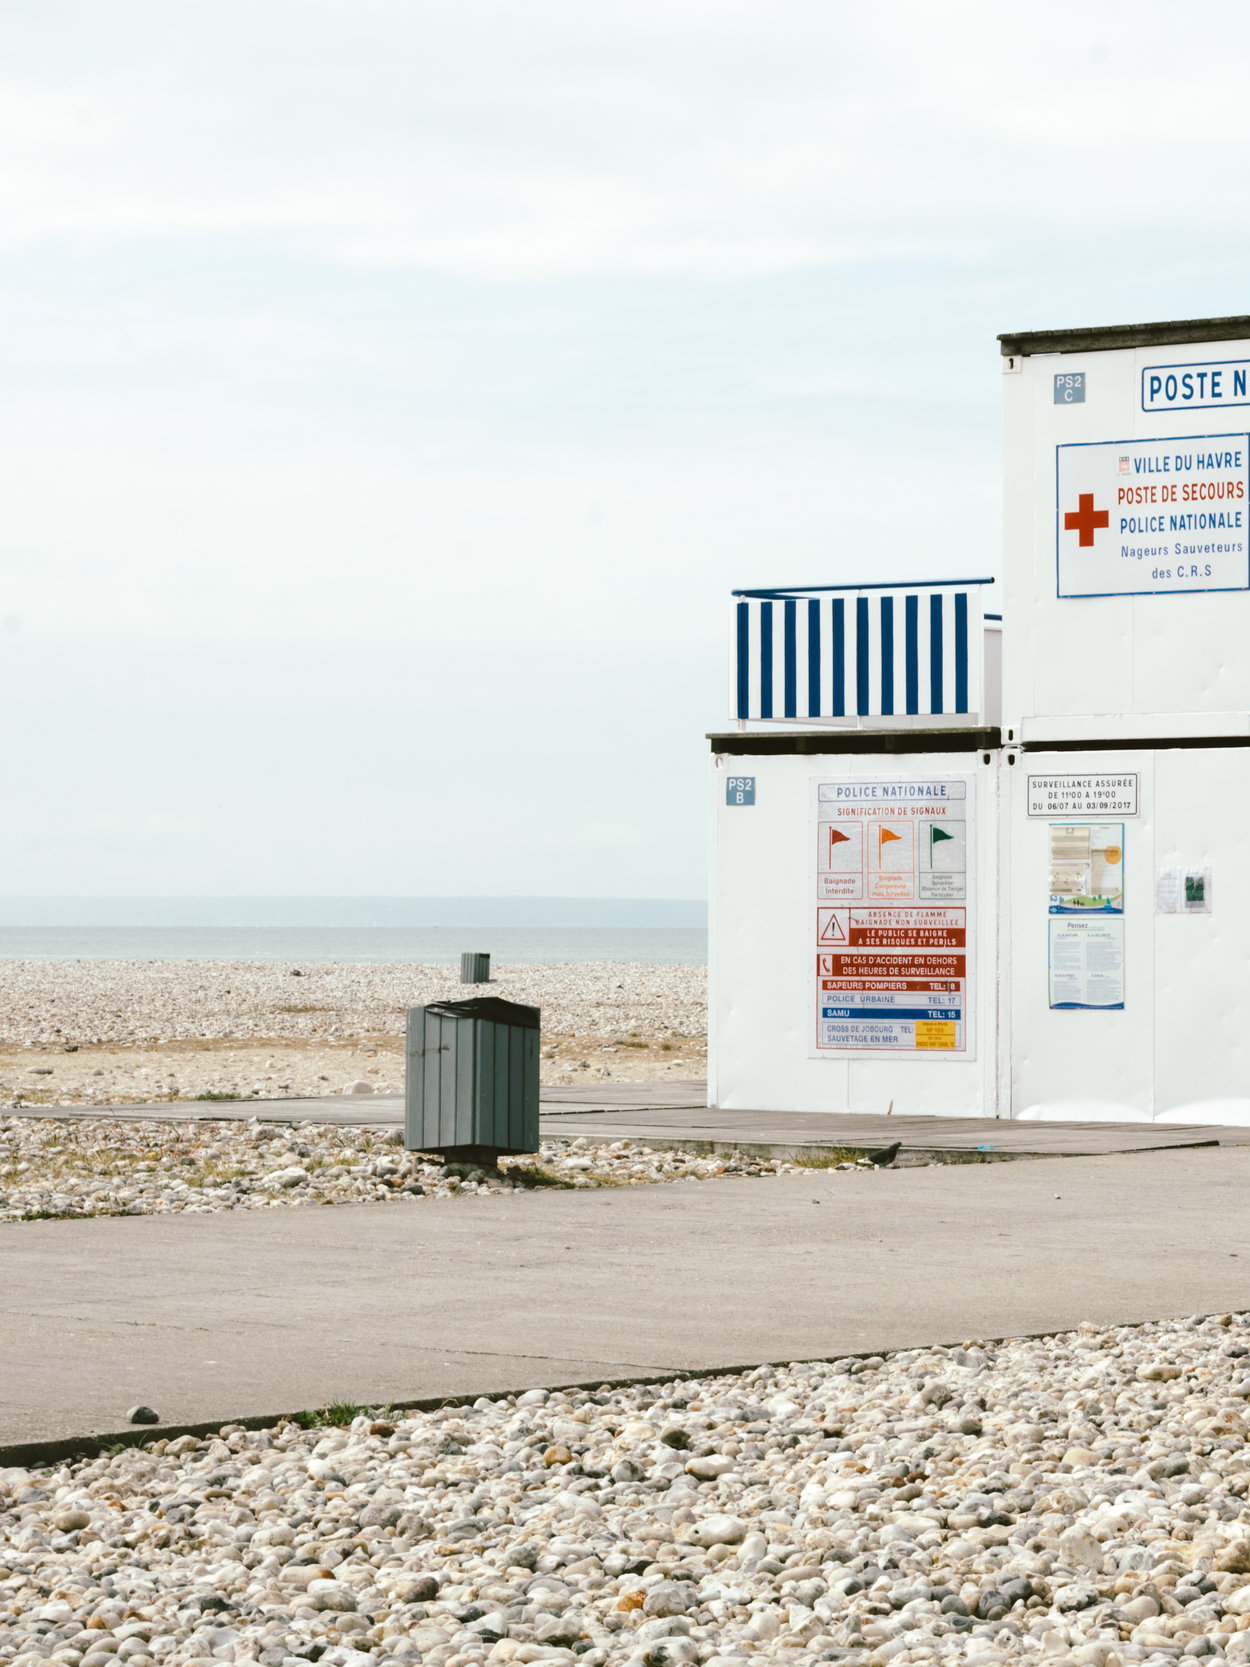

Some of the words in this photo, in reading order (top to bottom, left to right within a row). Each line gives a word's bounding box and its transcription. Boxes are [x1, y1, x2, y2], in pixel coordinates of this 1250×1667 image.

[1056, 375, 1082, 389] PS2
[1150, 371, 1222, 402] POSTE
[1064, 389, 1073, 401] C
[1134, 456, 1171, 474] VILLE
[1175, 454, 1192, 472] DU
[1197, 451, 1242, 470] HAVRE
[1118, 486, 1157, 505] POSTE
[1162, 484, 1177, 503] DE
[1182, 481, 1244, 502] SECOURS
[1120, 516, 1165, 534] POLICE
[1170, 511, 1242, 531] NATIONALE
[1121, 544, 1169, 560] Nageurs
[1174, 542, 1243, 555] Sauveteurs
[1152, 567, 1172, 579] des
[1177, 564, 1212, 578] C.R.S
[728, 778, 752, 791] PS2
[1032, 780, 1092, 789] SURVEILLANCE
[836, 786, 877, 798] POLICE
[882, 785, 947, 796] NATIONALE
[1048, 791, 1058, 799] DE
[1085, 791, 1090, 799] A
[736, 791, 745, 804] B
[1033, 802, 1043, 810] DU
[1047, 802, 1068, 810] 06/07
[1086, 802, 1131, 810] 03/09/2017
[837, 807, 895, 817] SIGNIFICATION
[897, 806, 908, 816] DE
[910, 806, 946, 815] SIGNAUX
[824, 877, 856, 886] Baignade
[825, 887, 854, 895] Interdite
[878, 929, 905, 937] PUBLIC
[908, 929, 917, 937] SE
[919, 929, 947, 937] BAIGNE
[882, 938, 915, 946] RISQUES
[929, 938, 957, 946] PERILS
[840, 956, 851, 964] EN
[852, 956, 866, 964] CAS
[868, 956, 913, 965] D'ACCIDENT
[914, 957, 925, 965] EN
[926, 957, 957, 965] DEHORS
[842, 967, 857, 975] DES
[858, 967, 887, 975] HEURES
[889, 967, 899, 975] DE
[901, 967, 955, 976] SURVEILLANCE
[827, 981, 863, 989] SAPEURS
[865, 982, 907, 990] POMPIERS
[929, 982, 946, 990] TEL:
[827, 995, 855, 1003] POLICE
[860, 995, 895, 1003] URBAINE
[928, 996, 946, 1004] TEL:
[827, 1009, 850, 1017] SAMU
[928, 1010, 945, 1018] TEL:
[947, 1010, 956, 1018] 15
[827, 1025, 849, 1033] CROSS
[850, 1025, 859, 1033] DE
[861, 1025, 893, 1034] JOBOURG
[827, 1035, 869, 1043] SAUVETAGE
[870, 1035, 880, 1043] EN
[882, 1035, 898, 1043] MER
